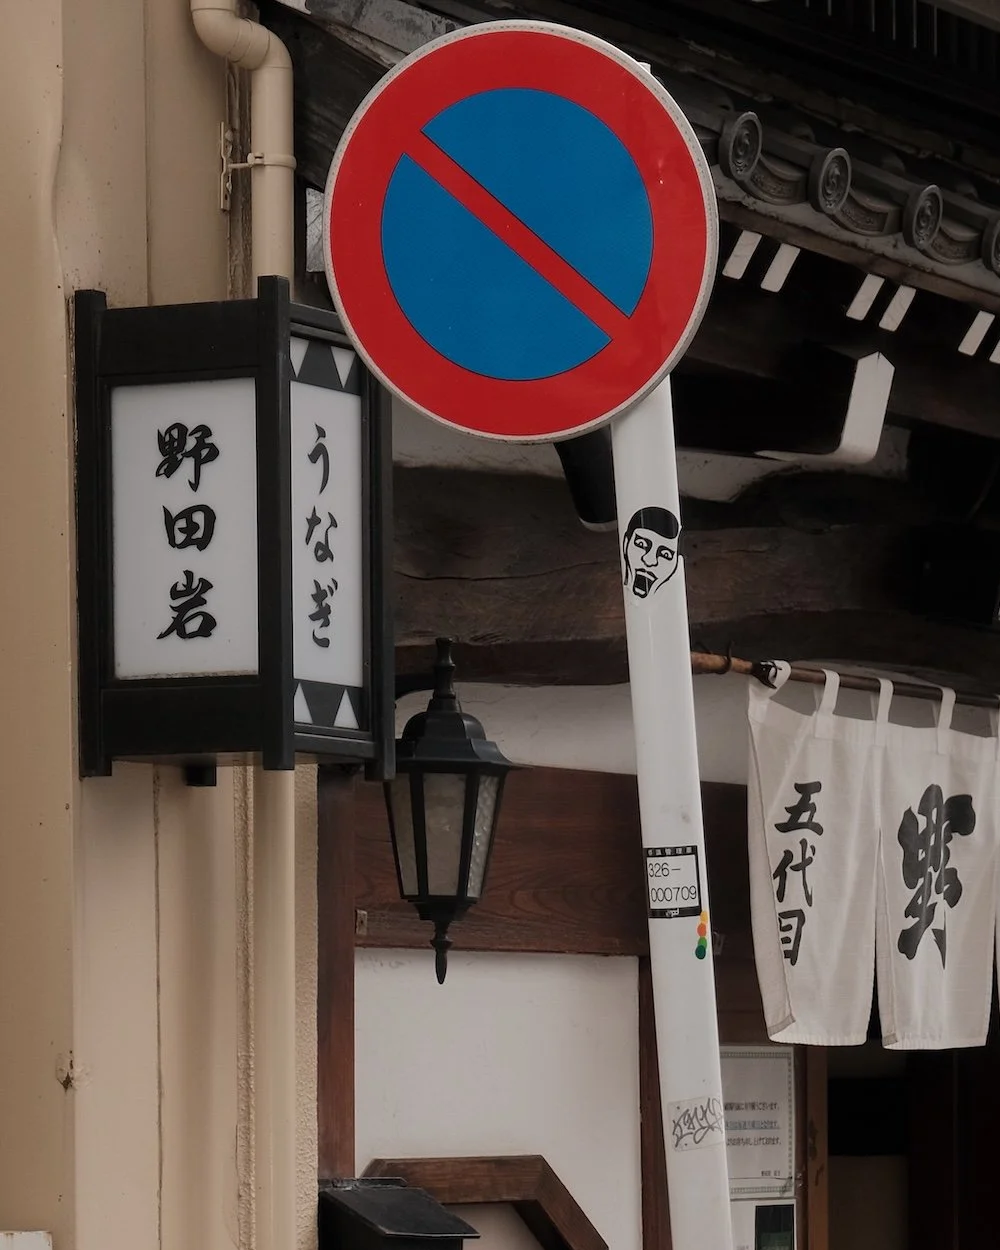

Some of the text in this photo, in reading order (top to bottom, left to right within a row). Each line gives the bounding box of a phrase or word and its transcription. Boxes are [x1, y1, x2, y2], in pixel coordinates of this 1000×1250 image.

[154, 421, 221, 642] 野田岩
[305, 422, 340, 649] うなぎ
[650, 885, 697, 903] 000709
[772, 780, 825, 967] 五代目
